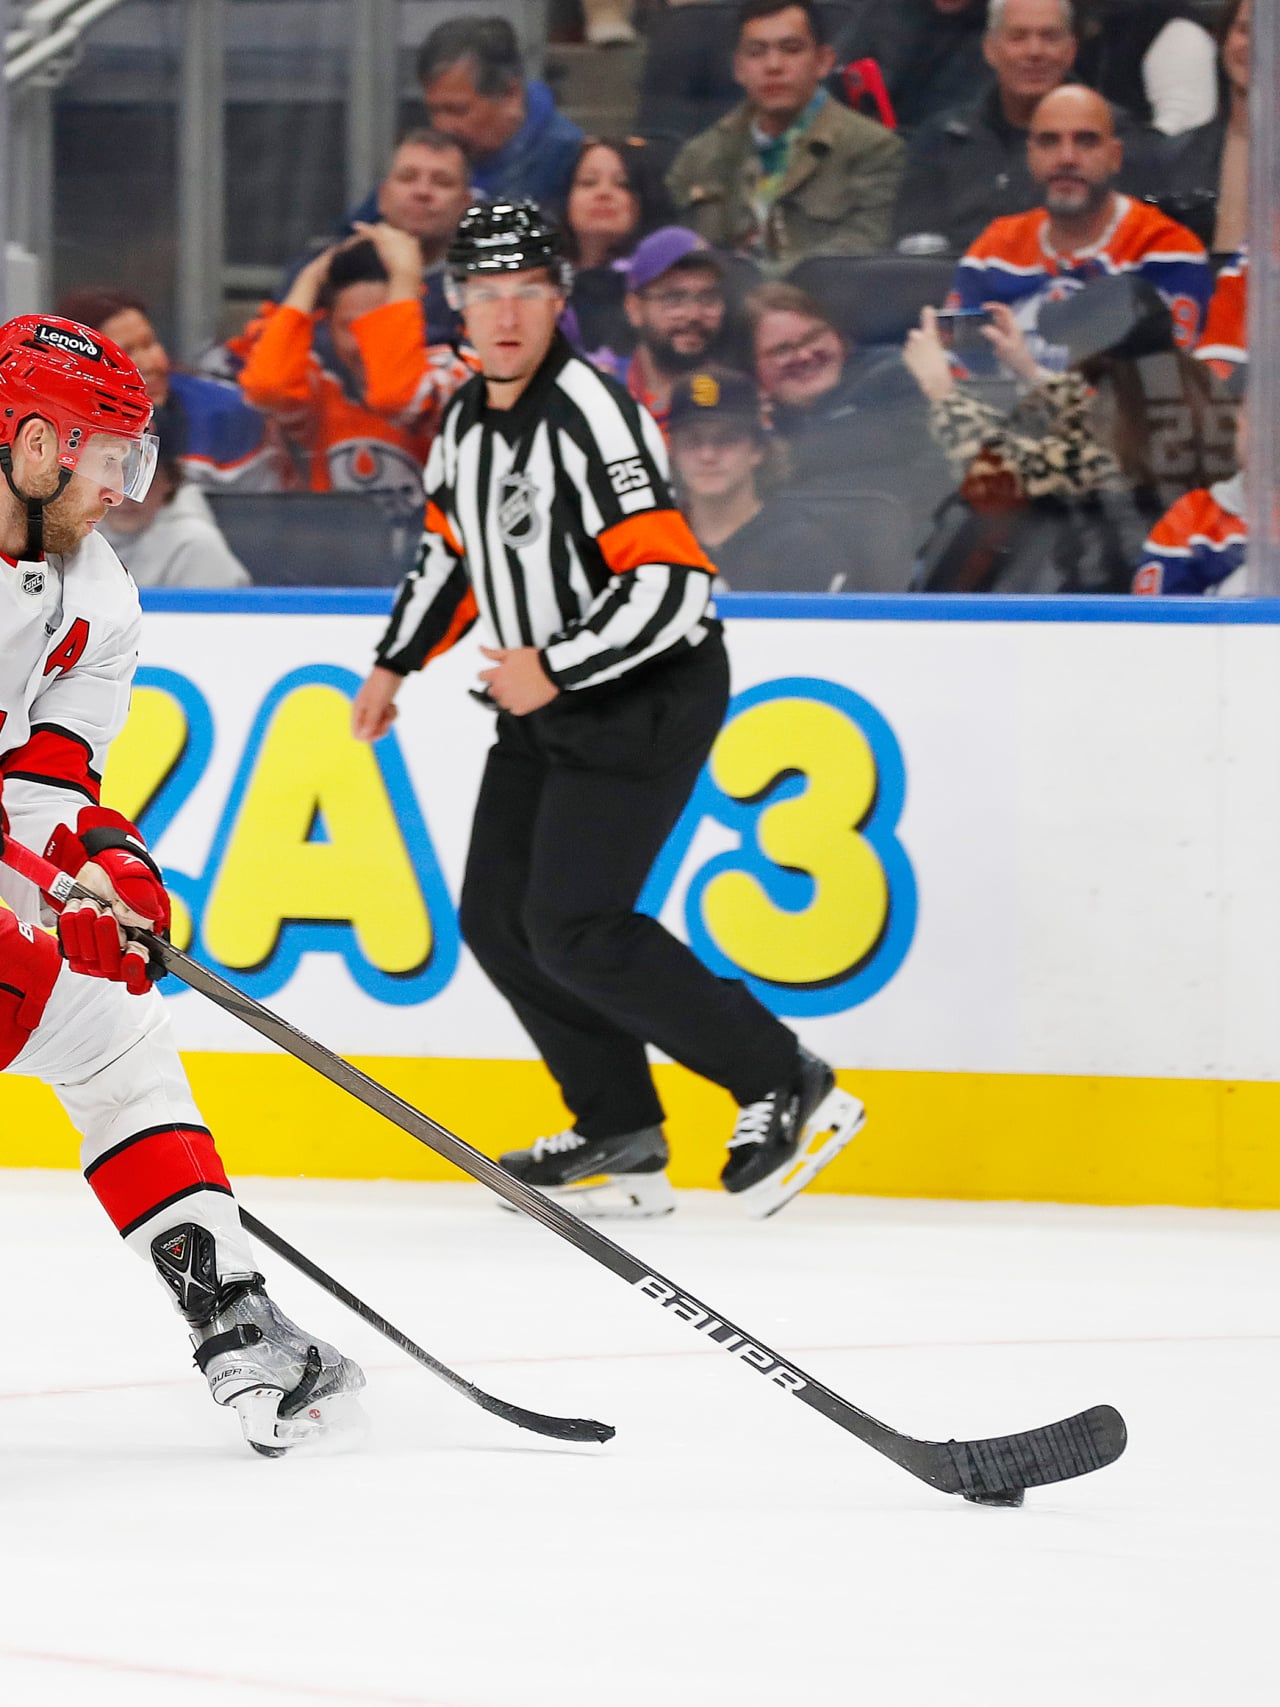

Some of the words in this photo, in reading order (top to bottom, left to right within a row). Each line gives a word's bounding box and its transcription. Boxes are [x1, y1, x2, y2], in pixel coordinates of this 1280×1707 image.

[39, 327, 98, 356] Lenovo
[607, 458, 651, 495] 25
[632, 1275, 808, 1397] BAUER
